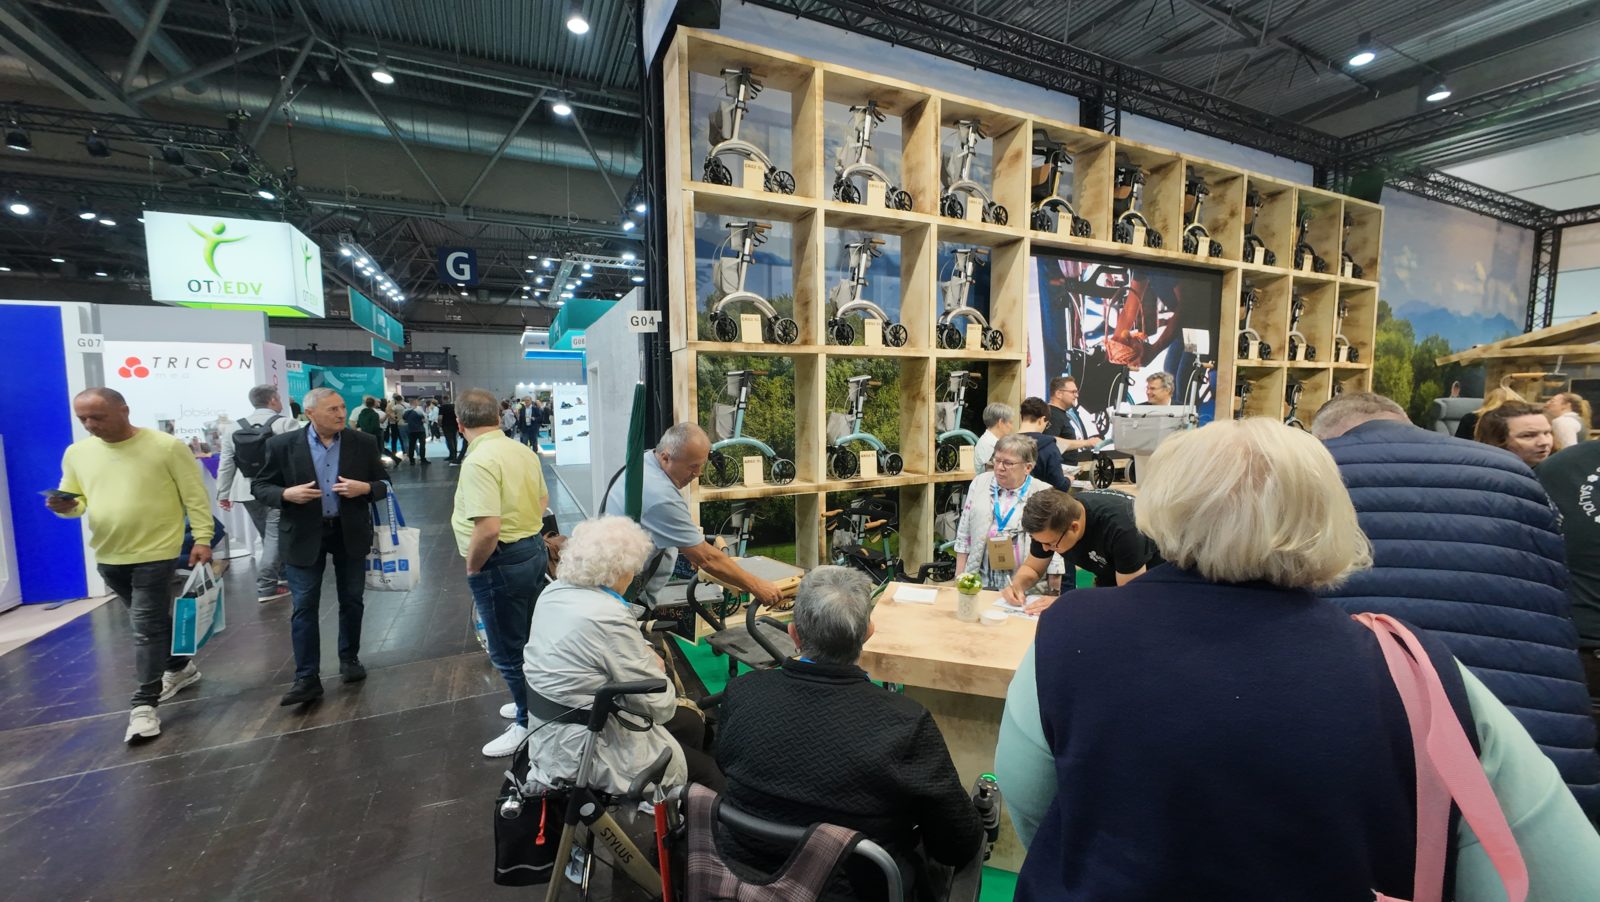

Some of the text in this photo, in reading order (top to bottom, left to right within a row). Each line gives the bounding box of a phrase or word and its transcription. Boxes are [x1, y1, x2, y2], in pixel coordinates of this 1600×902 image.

[445, 251, 471, 280] G
[630, 315, 655, 326] G04
[77, 338, 101, 347] G07
[152, 356, 252, 369] TRICON
[1579, 484, 1597, 516] SALJOL
[600, 827, 634, 864] STYLUS
